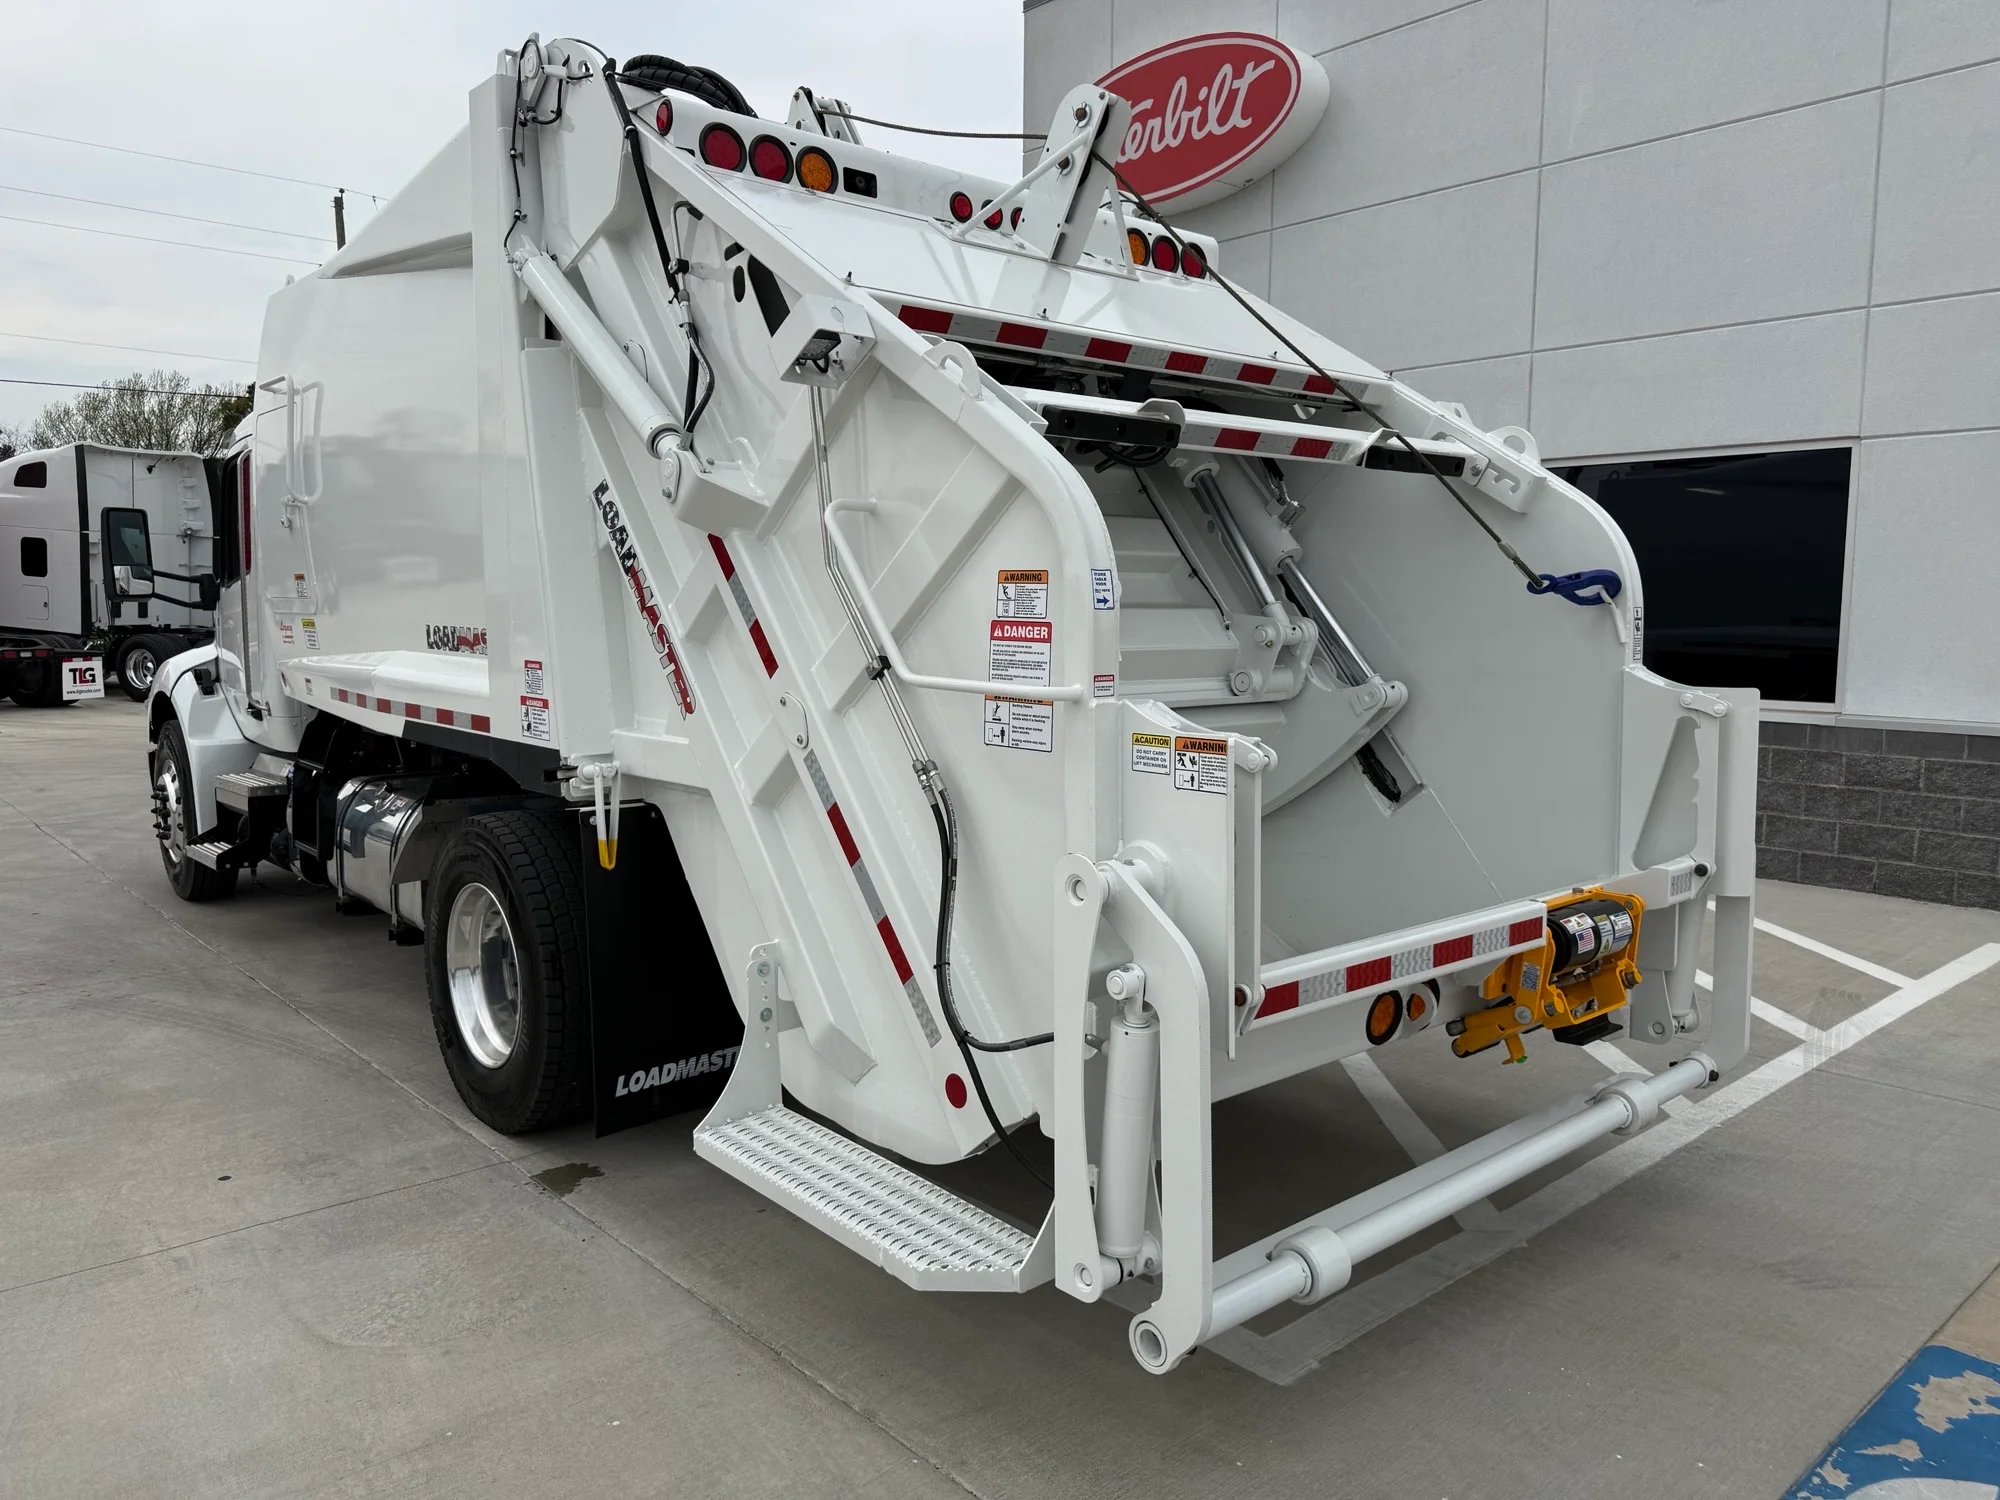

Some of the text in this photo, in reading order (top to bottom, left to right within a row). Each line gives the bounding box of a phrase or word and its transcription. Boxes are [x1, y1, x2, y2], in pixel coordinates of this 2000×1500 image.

[1009, 572, 1042, 582] WARNING
[592, 478, 697, 721] LOADMASTER
[1003, 625, 1049, 639] DANGER
[68, 666, 97, 685] TLG
[1139, 736, 1169, 747] CAUTION
[1143, 761, 1168, 769] MECHANISM
